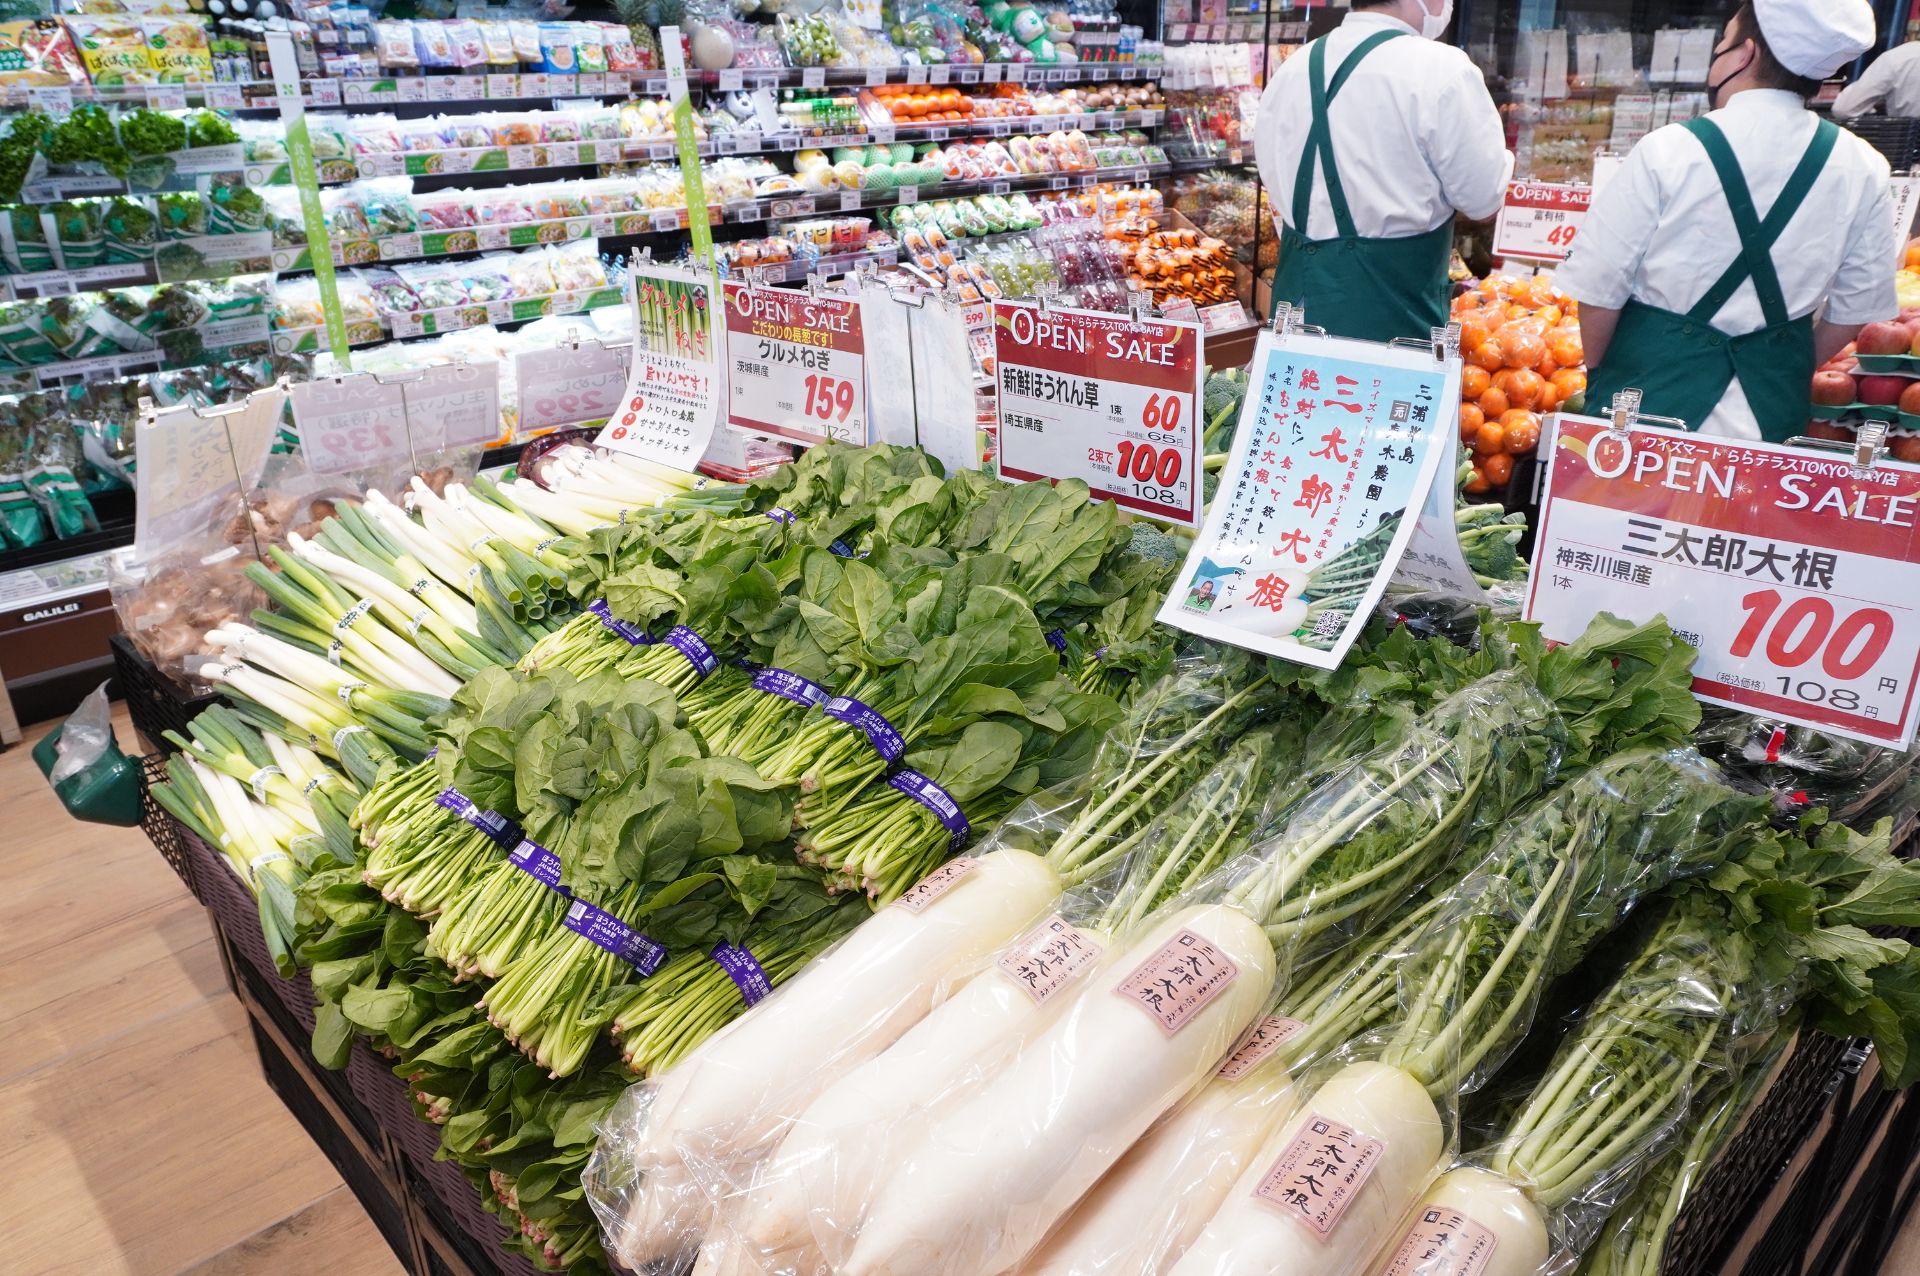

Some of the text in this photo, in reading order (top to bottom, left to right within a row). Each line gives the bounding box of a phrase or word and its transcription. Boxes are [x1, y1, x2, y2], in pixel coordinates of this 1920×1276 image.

[1513, 184, 1552, 201] OPEN
[1560, 191, 1591, 204] SALE
[1534, 209, 1566, 222] 富有柿
[1547, 225, 1579, 246] 49
[640, 282, 687, 315] グルメ
[675, 326, 708, 356] ねぎ
[735, 288, 850, 333] OPEN SALE
[966, 311, 984, 325] 599
[758, 339, 831, 371] グルメねぎ
[1010, 308, 1086, 354] OPEN
[1106, 332, 1175, 366] SALE
[736, 360, 769, 378] 茨城県産
[1003, 366, 1099, 410] 新鮮ほうれん草
[804, 374, 855, 424] 159
[853, 420, 860, 430] 円
[1004, 413, 1044, 433] 埼玉県産
[1110, 404, 1122, 415] 1束
[1143, 393, 1181, 431] 60
[821, 424, 851, 441] 172
[1148, 431, 1176, 444] 65
[1399, 384, 1433, 464] 三浦半島
[1088, 440, 1187, 491] 2束で 100 円
[1587, 430, 1918, 528] OPEN SALE
[1645, 435, 1900, 487] ワイズマート ららテラスTOKYO-AY店
[1132, 483, 1175, 504] 108
[1176, 499, 1182, 508] 円
[1246, 374, 1363, 613] 三太郎大根
[1556, 546, 1653, 586] 神奈川県産
[1621, 518, 1838, 590] 三太郎大根
[1552, 574, 1573, 590] 1本
[23, 602, 80, 622] GALILEI
[1730, 588, 1894, 681] 100
[1878, 676, 1898, 694] 円
[1776, 676, 1861, 711] 108
[1863, 704, 1879, 719] 円
[862, 710, 892, 736] ほうれん草
[595, 913, 632, 939] ほうれん草
[1017, 932, 1083, 989] 三太郎大根
[1138, 945, 1216, 1013] 三太郎大根
[1282, 1129, 1357, 1216] 三太郎大根
[1415, 1215, 1471, 1276] 三太郎
